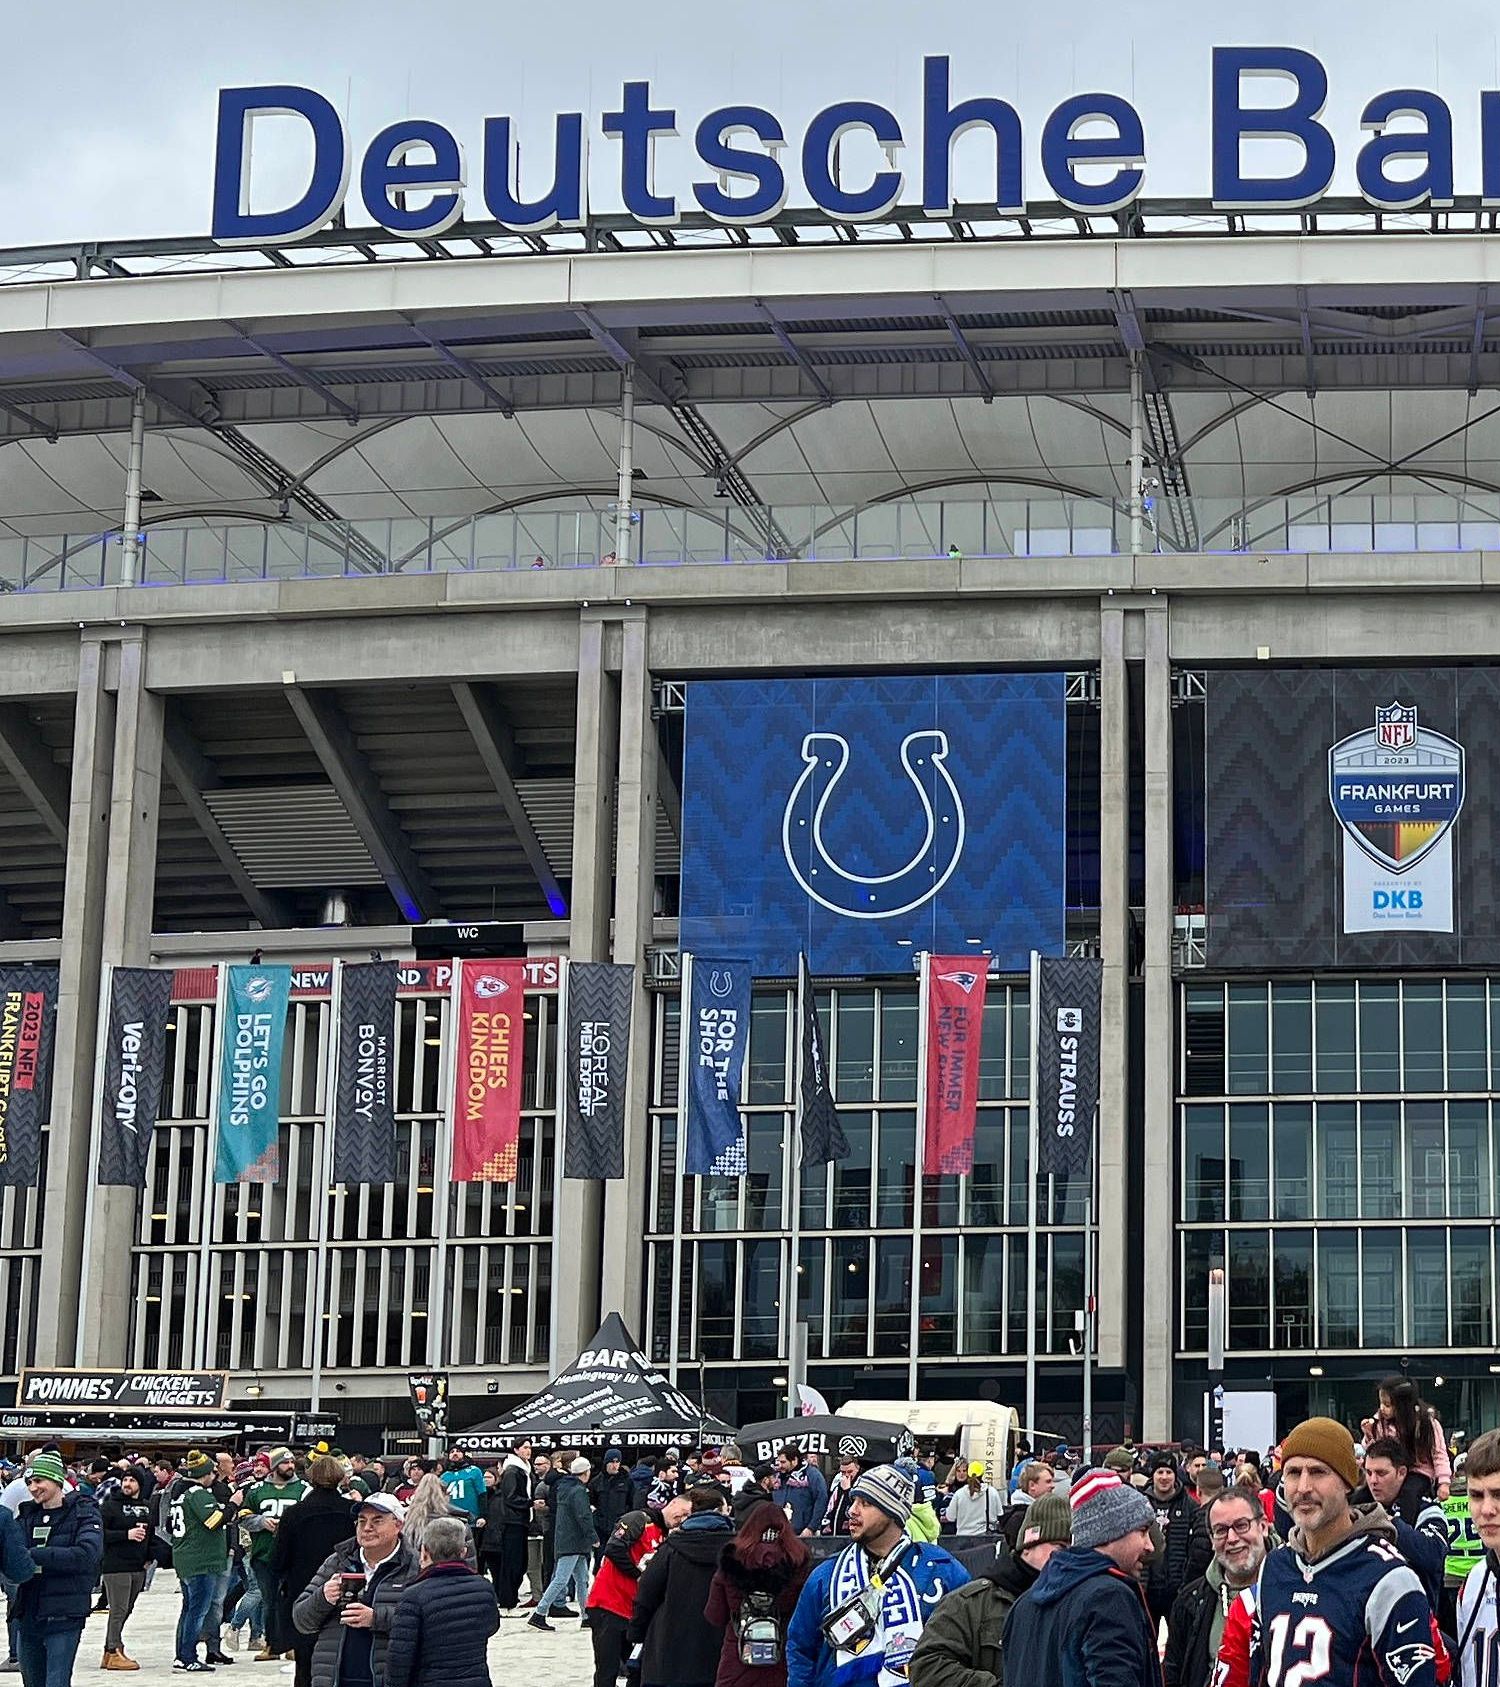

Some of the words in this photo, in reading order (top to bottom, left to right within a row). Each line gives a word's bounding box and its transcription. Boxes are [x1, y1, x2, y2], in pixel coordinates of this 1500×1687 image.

[212, 55, 1147, 246] Deutsche
[1381, 724, 1412, 746] NFL
[1384, 757, 1410, 765] 2023
[1340, 783, 1455, 801] FRANKFURT
[1374, 804, 1421, 814] GAMES
[1373, 890, 1424, 910] DKB
[457, 927, 479, 939] WC
[289, 972, 329, 989] NEW
[22, 1001, 41, 1041] 2023
[579, 1021, 594, 1056] MEN
[714, 1008, 738, 1053] FOR
[251, 1012, 272, 1070] LET'S
[487, 1012, 511, 1089] CHIEFS
[16, 1048, 34, 1082] NFL
[115, 1021, 145, 1135] verizon
[229, 1013, 253, 1127] DOLPHINS
[354, 1024, 375, 1121] BONVOY
[375, 1036, 387, 1106] MARRIOTT
[466, 1011, 490, 1121] KINGDOM
[591, 1021, 611, 1116] L'ORÉAL
[714, 1056, 731, 1101] THE
[945, 1049, 966, 1113] IMMER
[250, 1073, 268, 1110] GO
[578, 1057, 593, 1117] EXPERT
[1055, 1036, 1078, 1138] STRAUSS
[576, 1348, 630, 1370] BAR
[25, 1377, 114, 1400] POMMES
[553, 1370, 623, 1386] Hemingway
[144, 1390, 216, 1405] NUGGETS
[558, 1394, 624, 1425] CAIPIRINHA
[456, 1435, 557, 1449] COCKTLS,
[560, 1434, 608, 1447] SEKT
[608, 1434, 622, 1445] &
[627, 1433, 692, 1446] DRINKS
[884, 1471, 914, 1501] THE
[1267, 1612, 1335, 1687] 12
